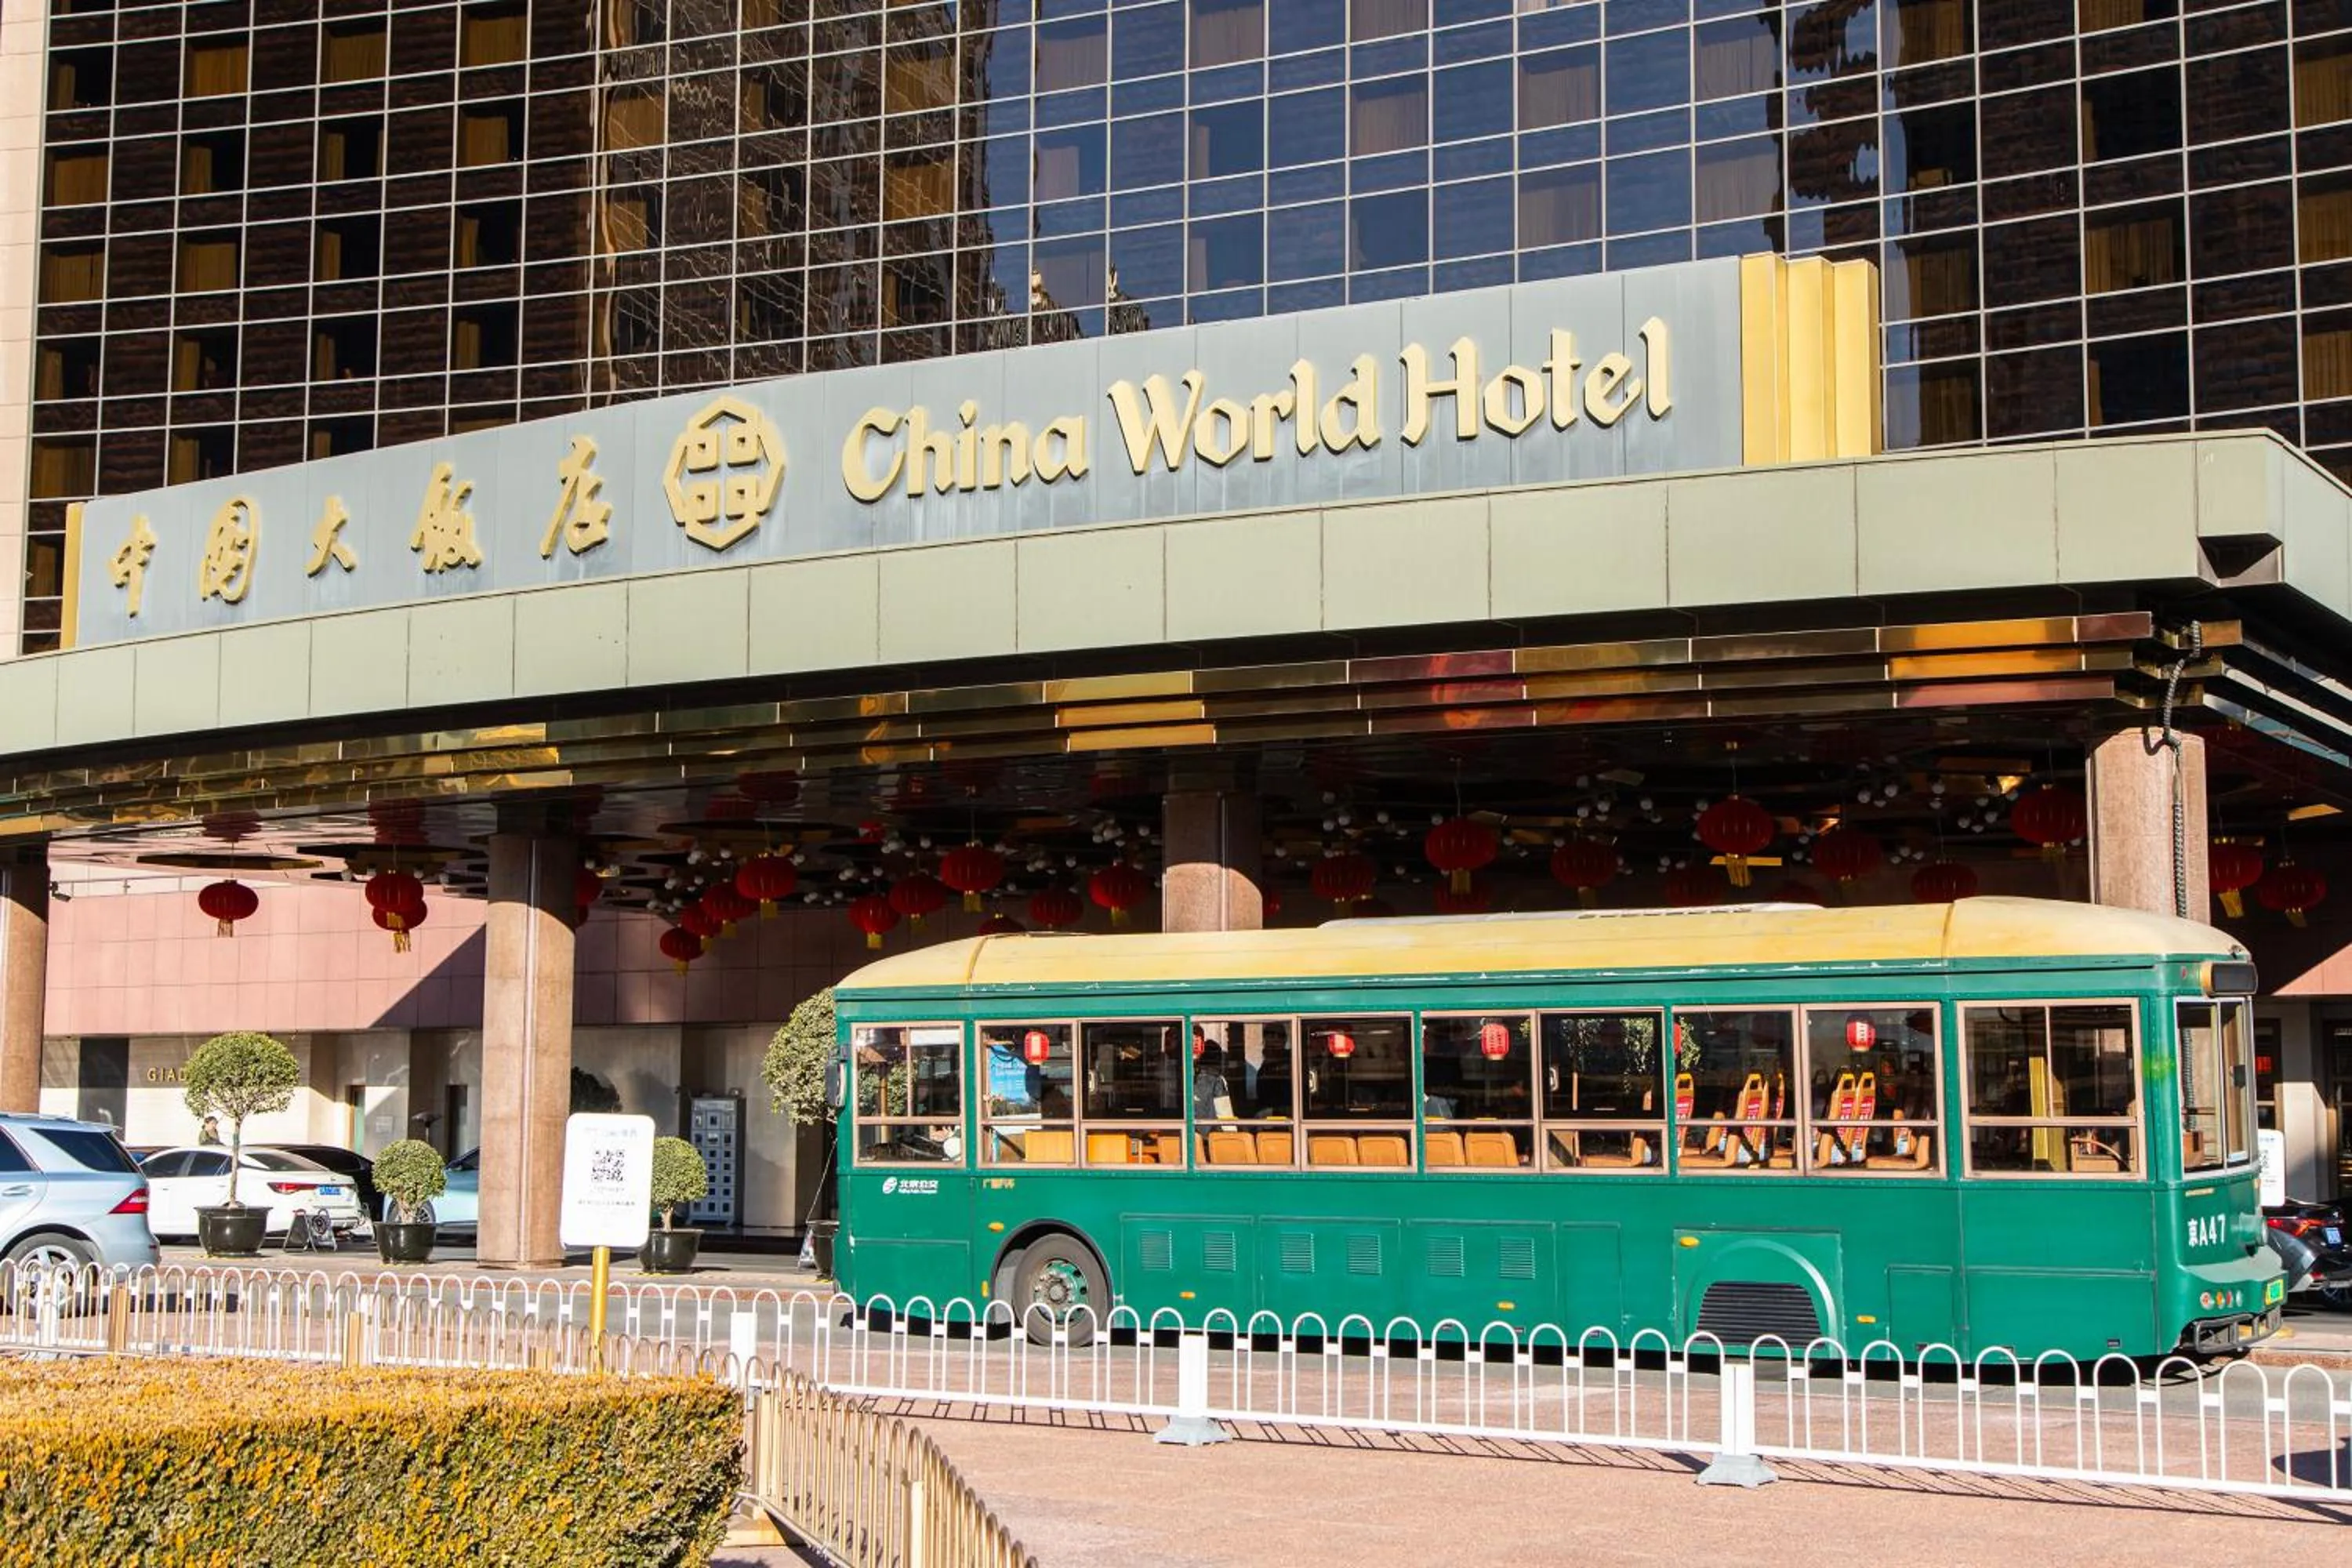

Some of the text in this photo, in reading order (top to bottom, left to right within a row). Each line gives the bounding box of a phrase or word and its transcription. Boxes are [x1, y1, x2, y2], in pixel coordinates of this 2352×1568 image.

[842, 316, 1672, 504] China World Hotel
